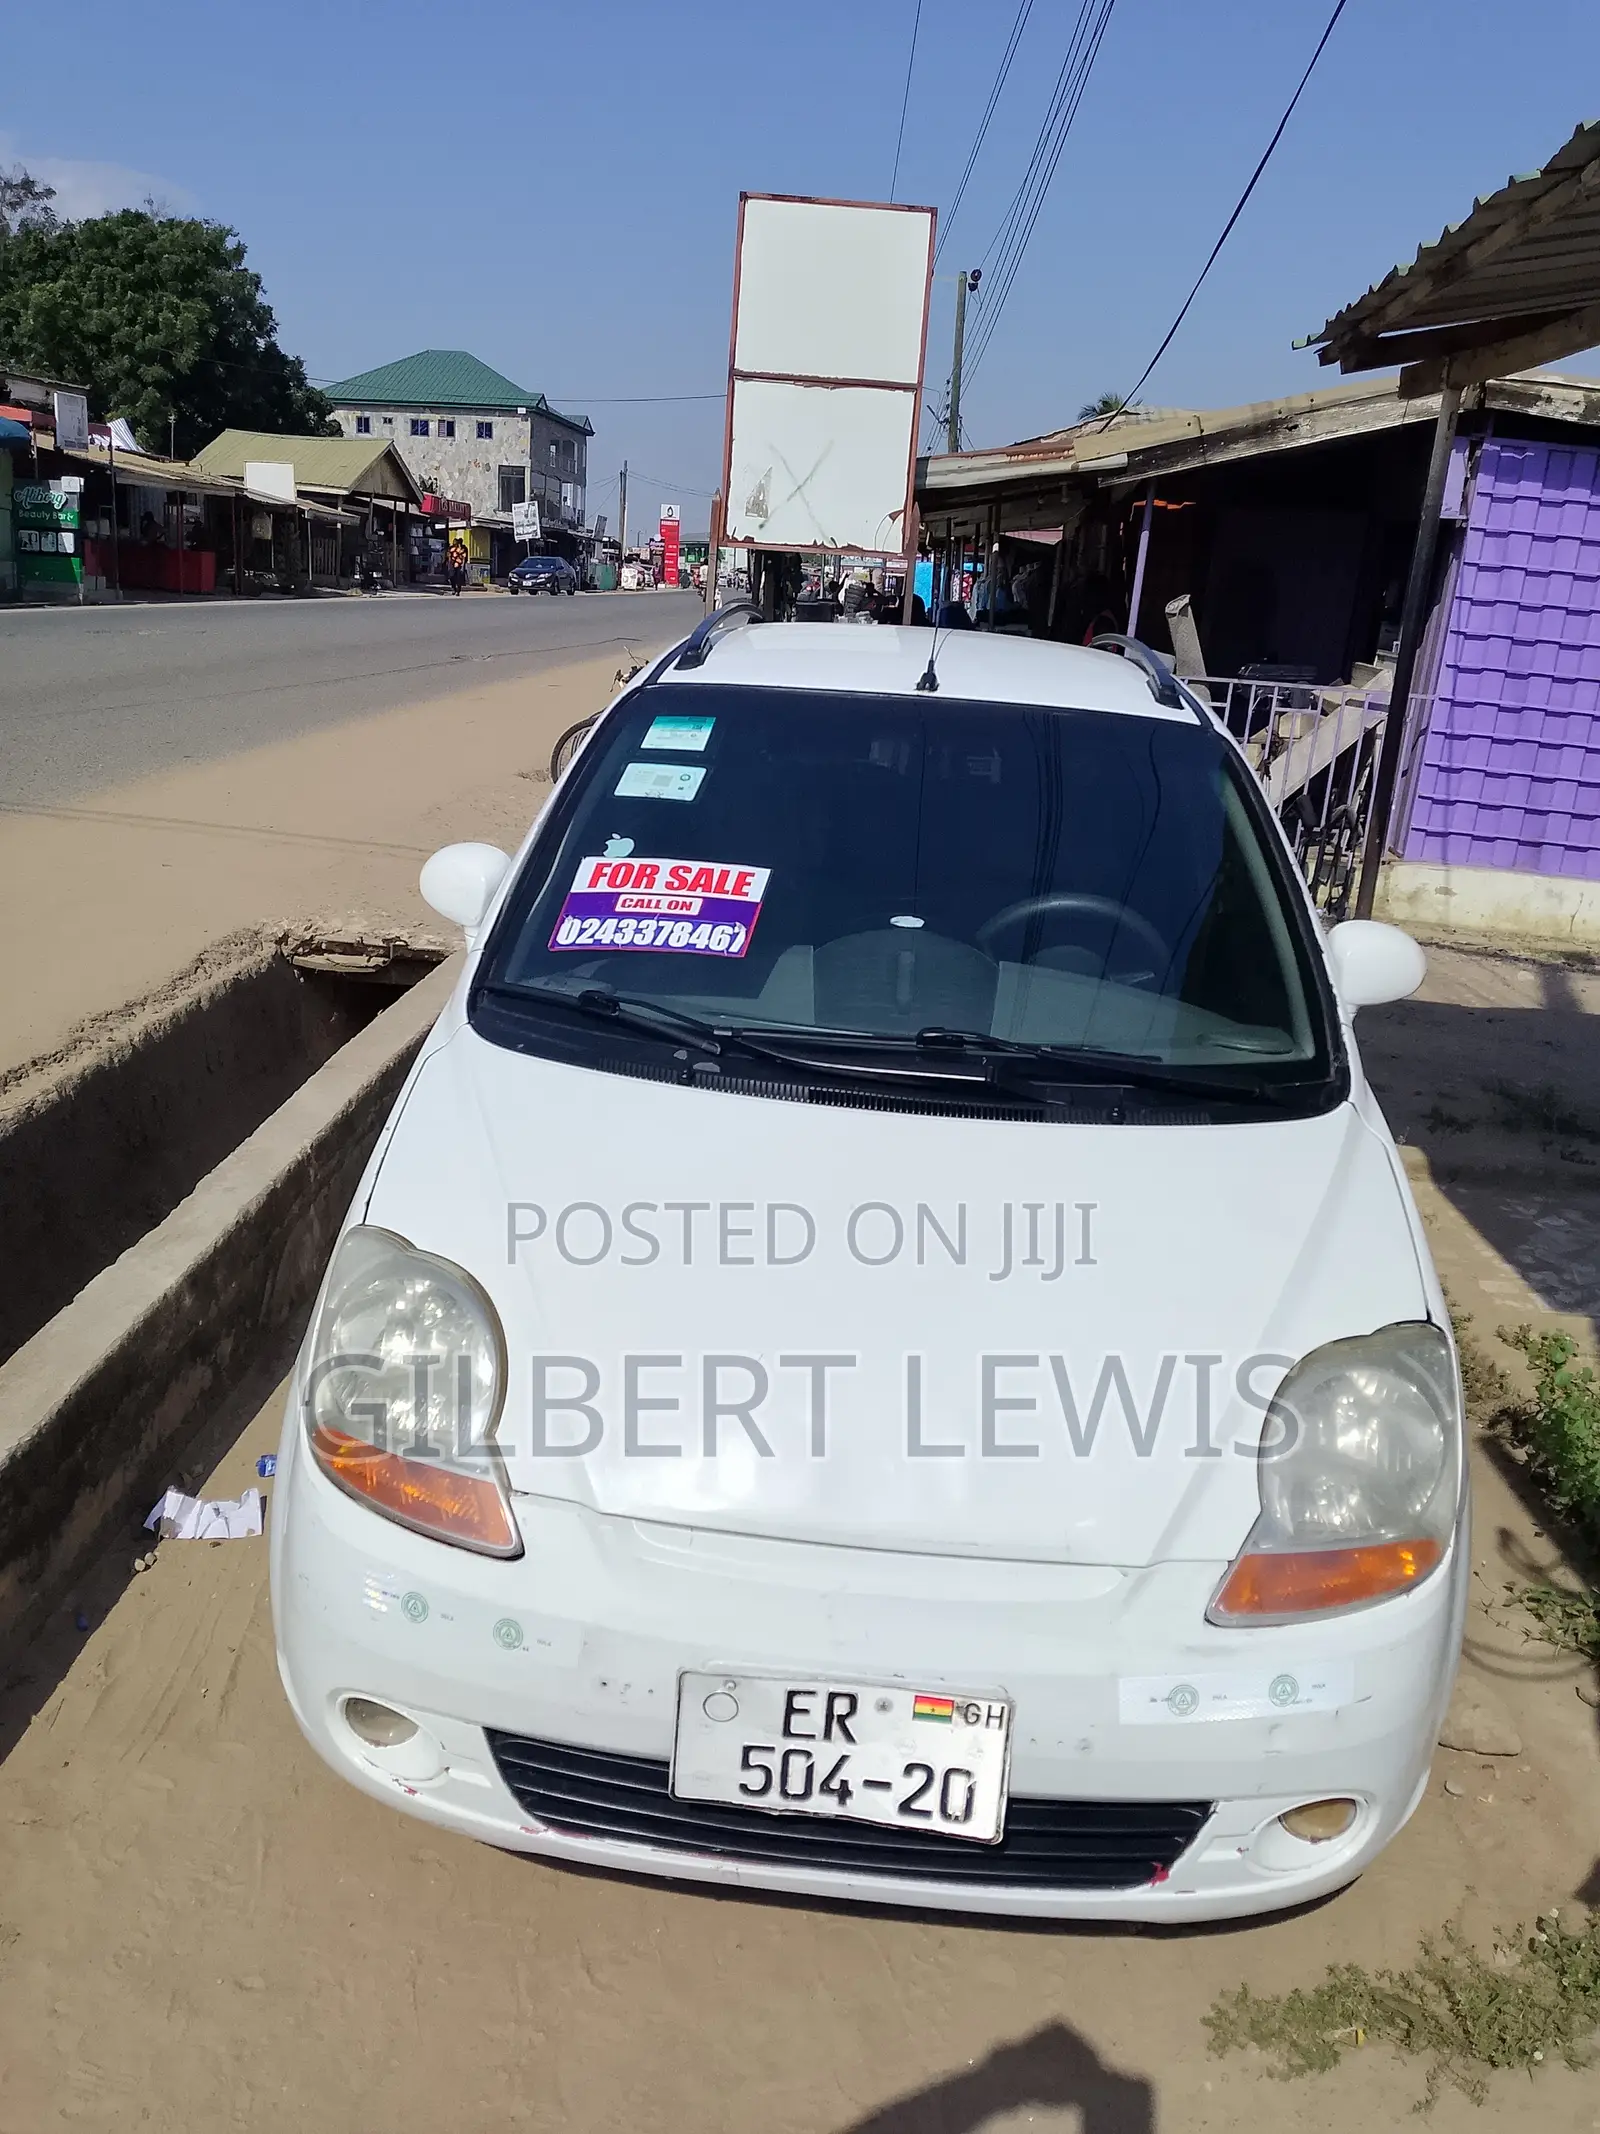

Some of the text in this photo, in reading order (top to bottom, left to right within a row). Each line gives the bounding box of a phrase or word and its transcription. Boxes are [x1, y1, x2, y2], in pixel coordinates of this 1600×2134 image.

[19, 510, 50, 520] Beauty
[53, 512, 66, 520] Bar
[587, 862, 755, 896] FOR SALE
[620, 897, 693, 911] CALL ON
[556, 917, 747, 953] 0243378467
[782, 1687, 859, 1744] ER
[963, 1702, 1005, 1731] GH
[738, 1744, 977, 1824] 504-20
